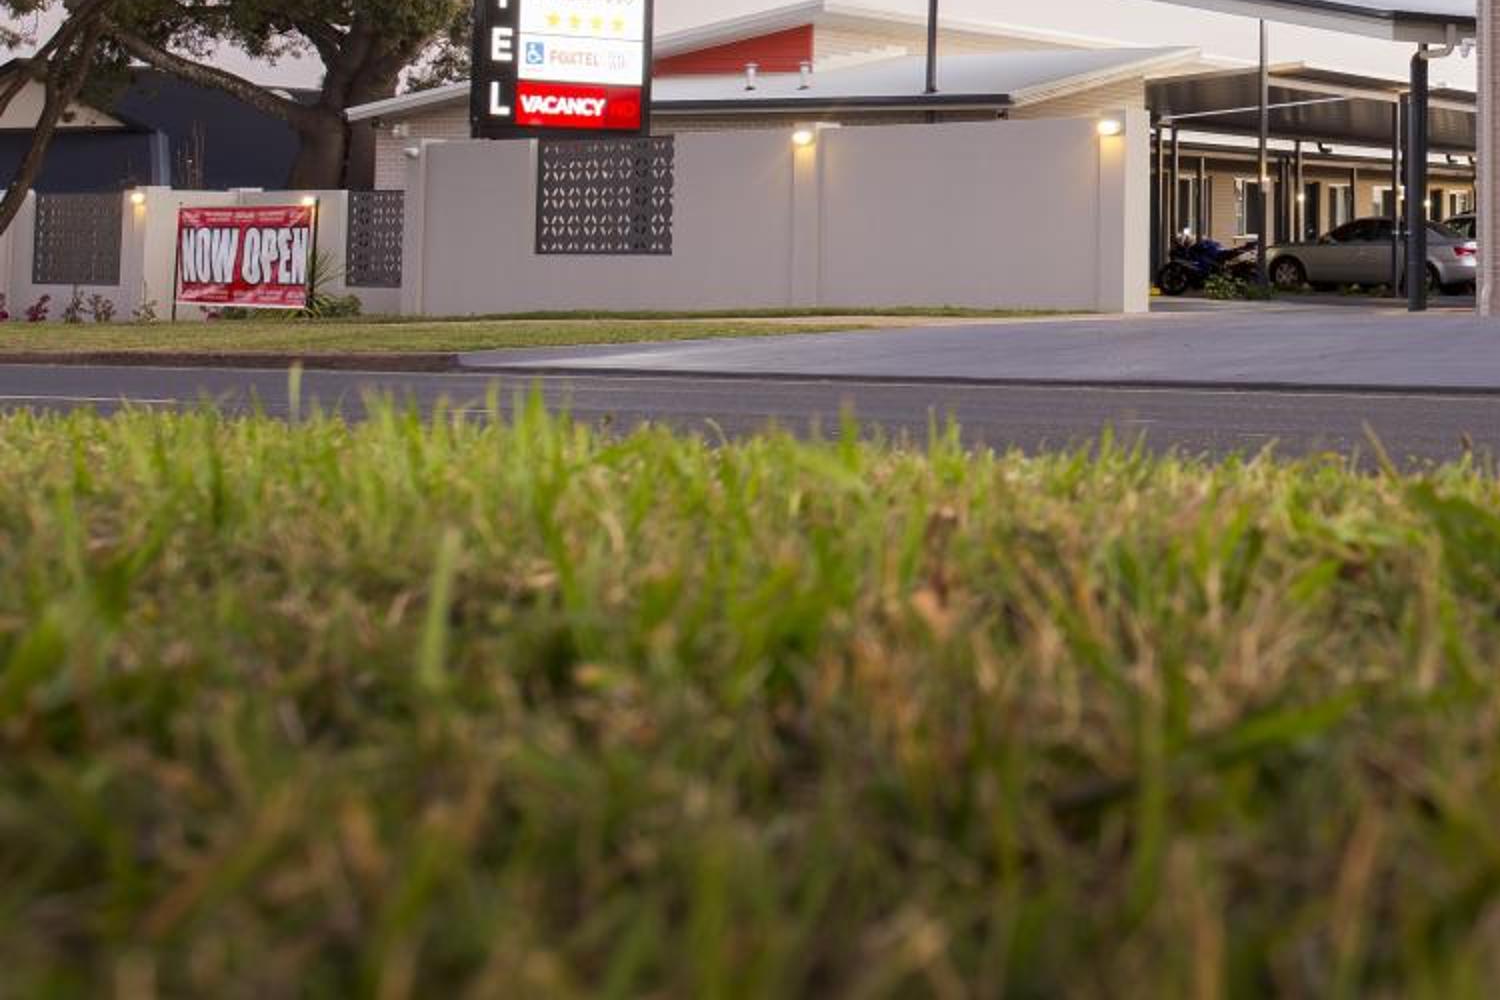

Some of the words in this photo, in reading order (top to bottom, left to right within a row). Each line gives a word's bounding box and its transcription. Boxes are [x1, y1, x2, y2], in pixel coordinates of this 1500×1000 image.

[520, 94, 606, 117] VACANCY
[182, 226, 240, 284] NOW
[241, 226, 309, 285] OPEN
